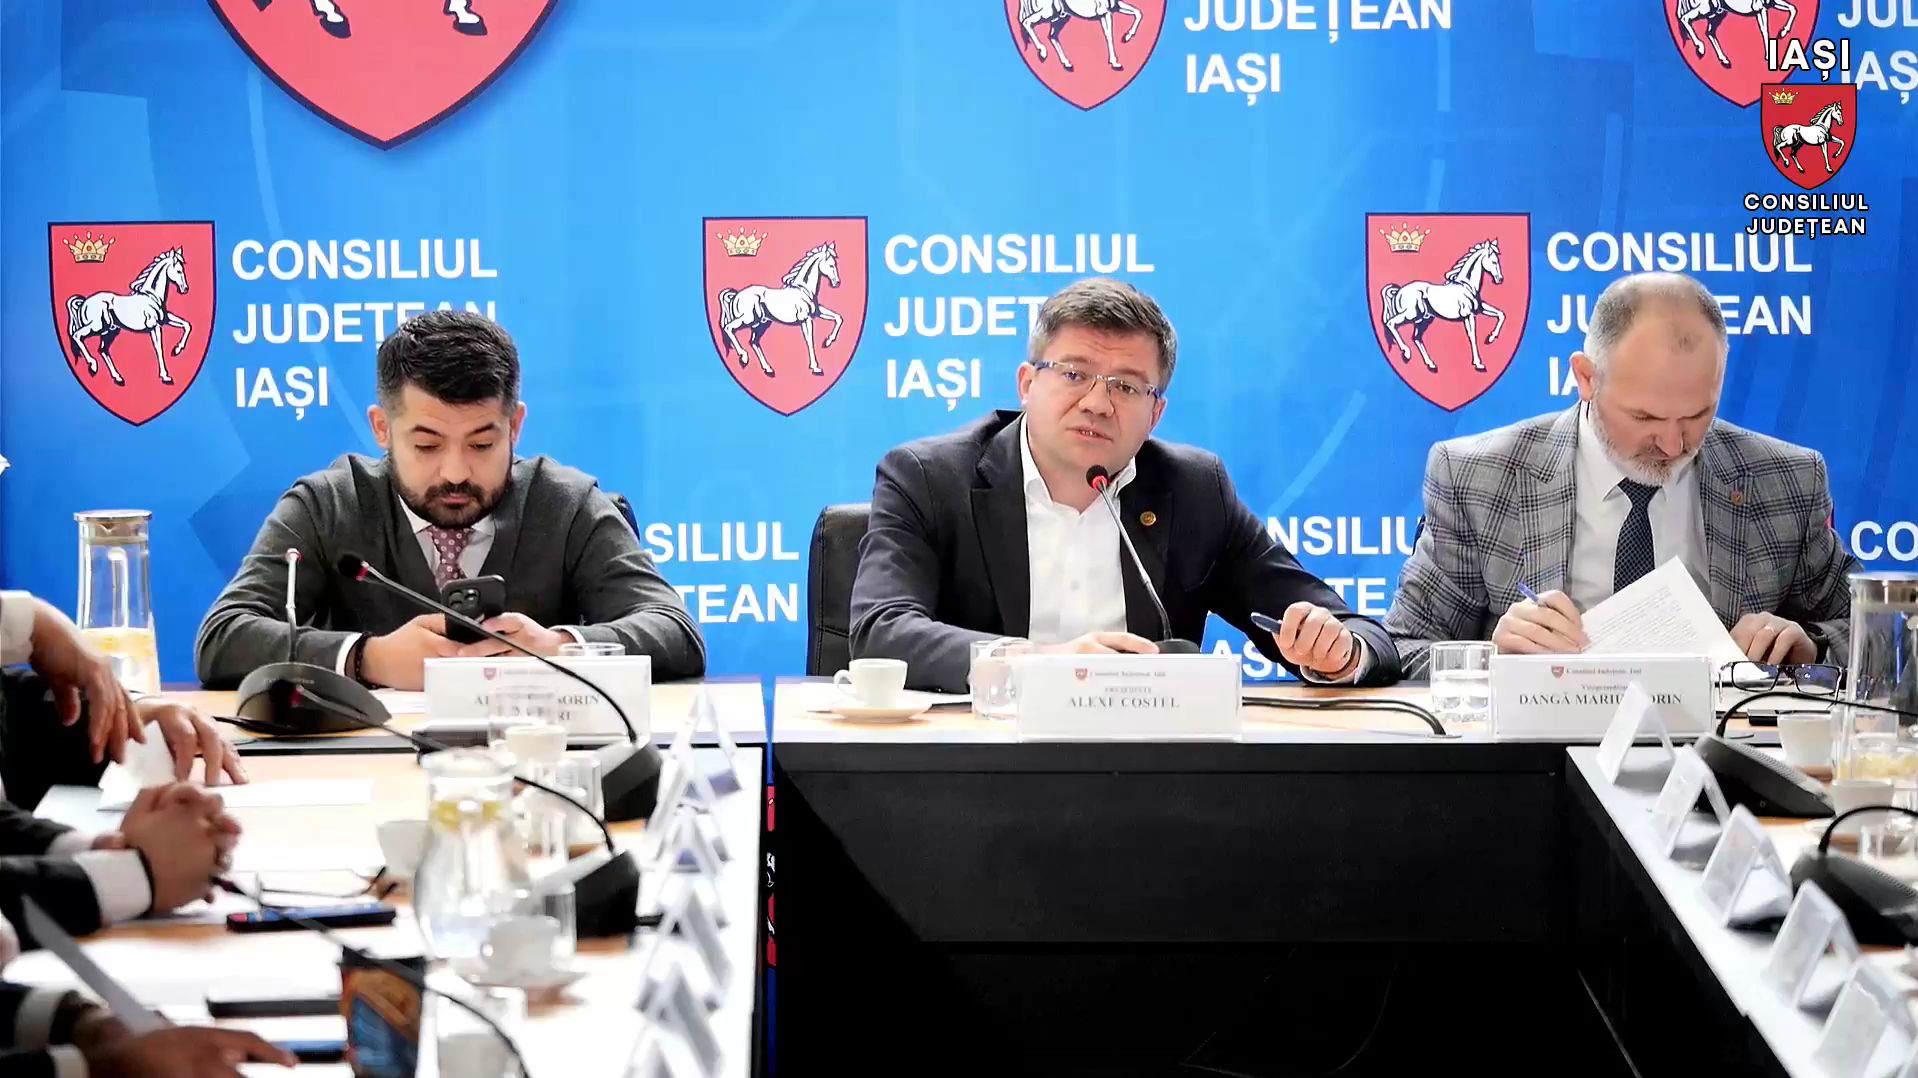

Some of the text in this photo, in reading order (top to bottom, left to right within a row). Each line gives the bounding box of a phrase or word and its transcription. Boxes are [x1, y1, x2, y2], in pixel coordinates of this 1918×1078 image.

[1186, 53, 1280, 106] IAȘI
[231, 238, 498, 280] CONSILIUL
[884, 234, 1155, 275] CONSILIUL
[1547, 232, 1813, 272] CONSILIUL
[235, 366, 328, 420] IAȘI
[887, 359, 981, 411] IAȘI
[643, 521, 800, 564] SILIUL
[1576, 693, 1625, 705] MARIU
